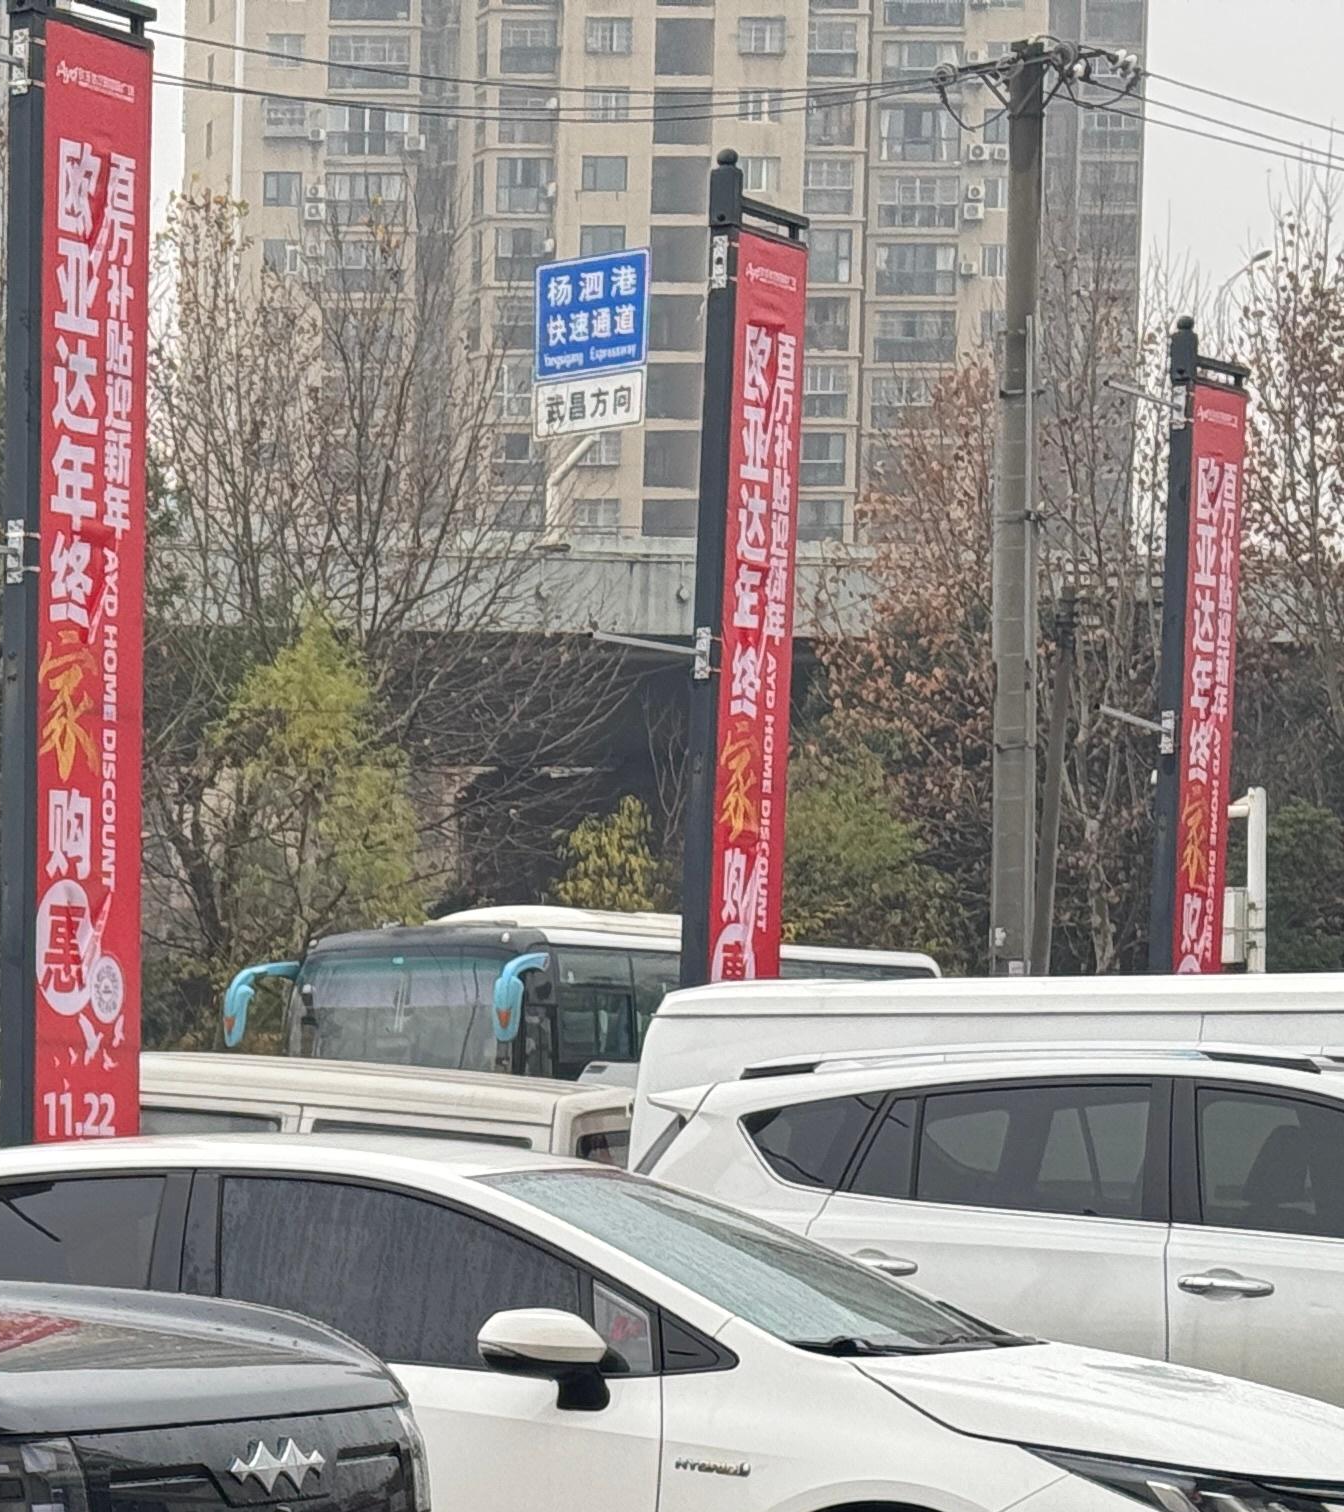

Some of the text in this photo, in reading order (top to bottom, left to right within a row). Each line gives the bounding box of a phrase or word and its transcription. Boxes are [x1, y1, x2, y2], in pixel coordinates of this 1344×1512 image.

[547, 265, 637, 308] 杨泗港
[546, 303, 636, 347] 快速通道
[545, 385, 632, 426] 武昌方向
[38, 137, 101, 992] 欧亚达年终家购惠
[100, 547, 119, 893] AYD HOME DISCOUNT
[43, 1091, 116, 1137] 11.22
